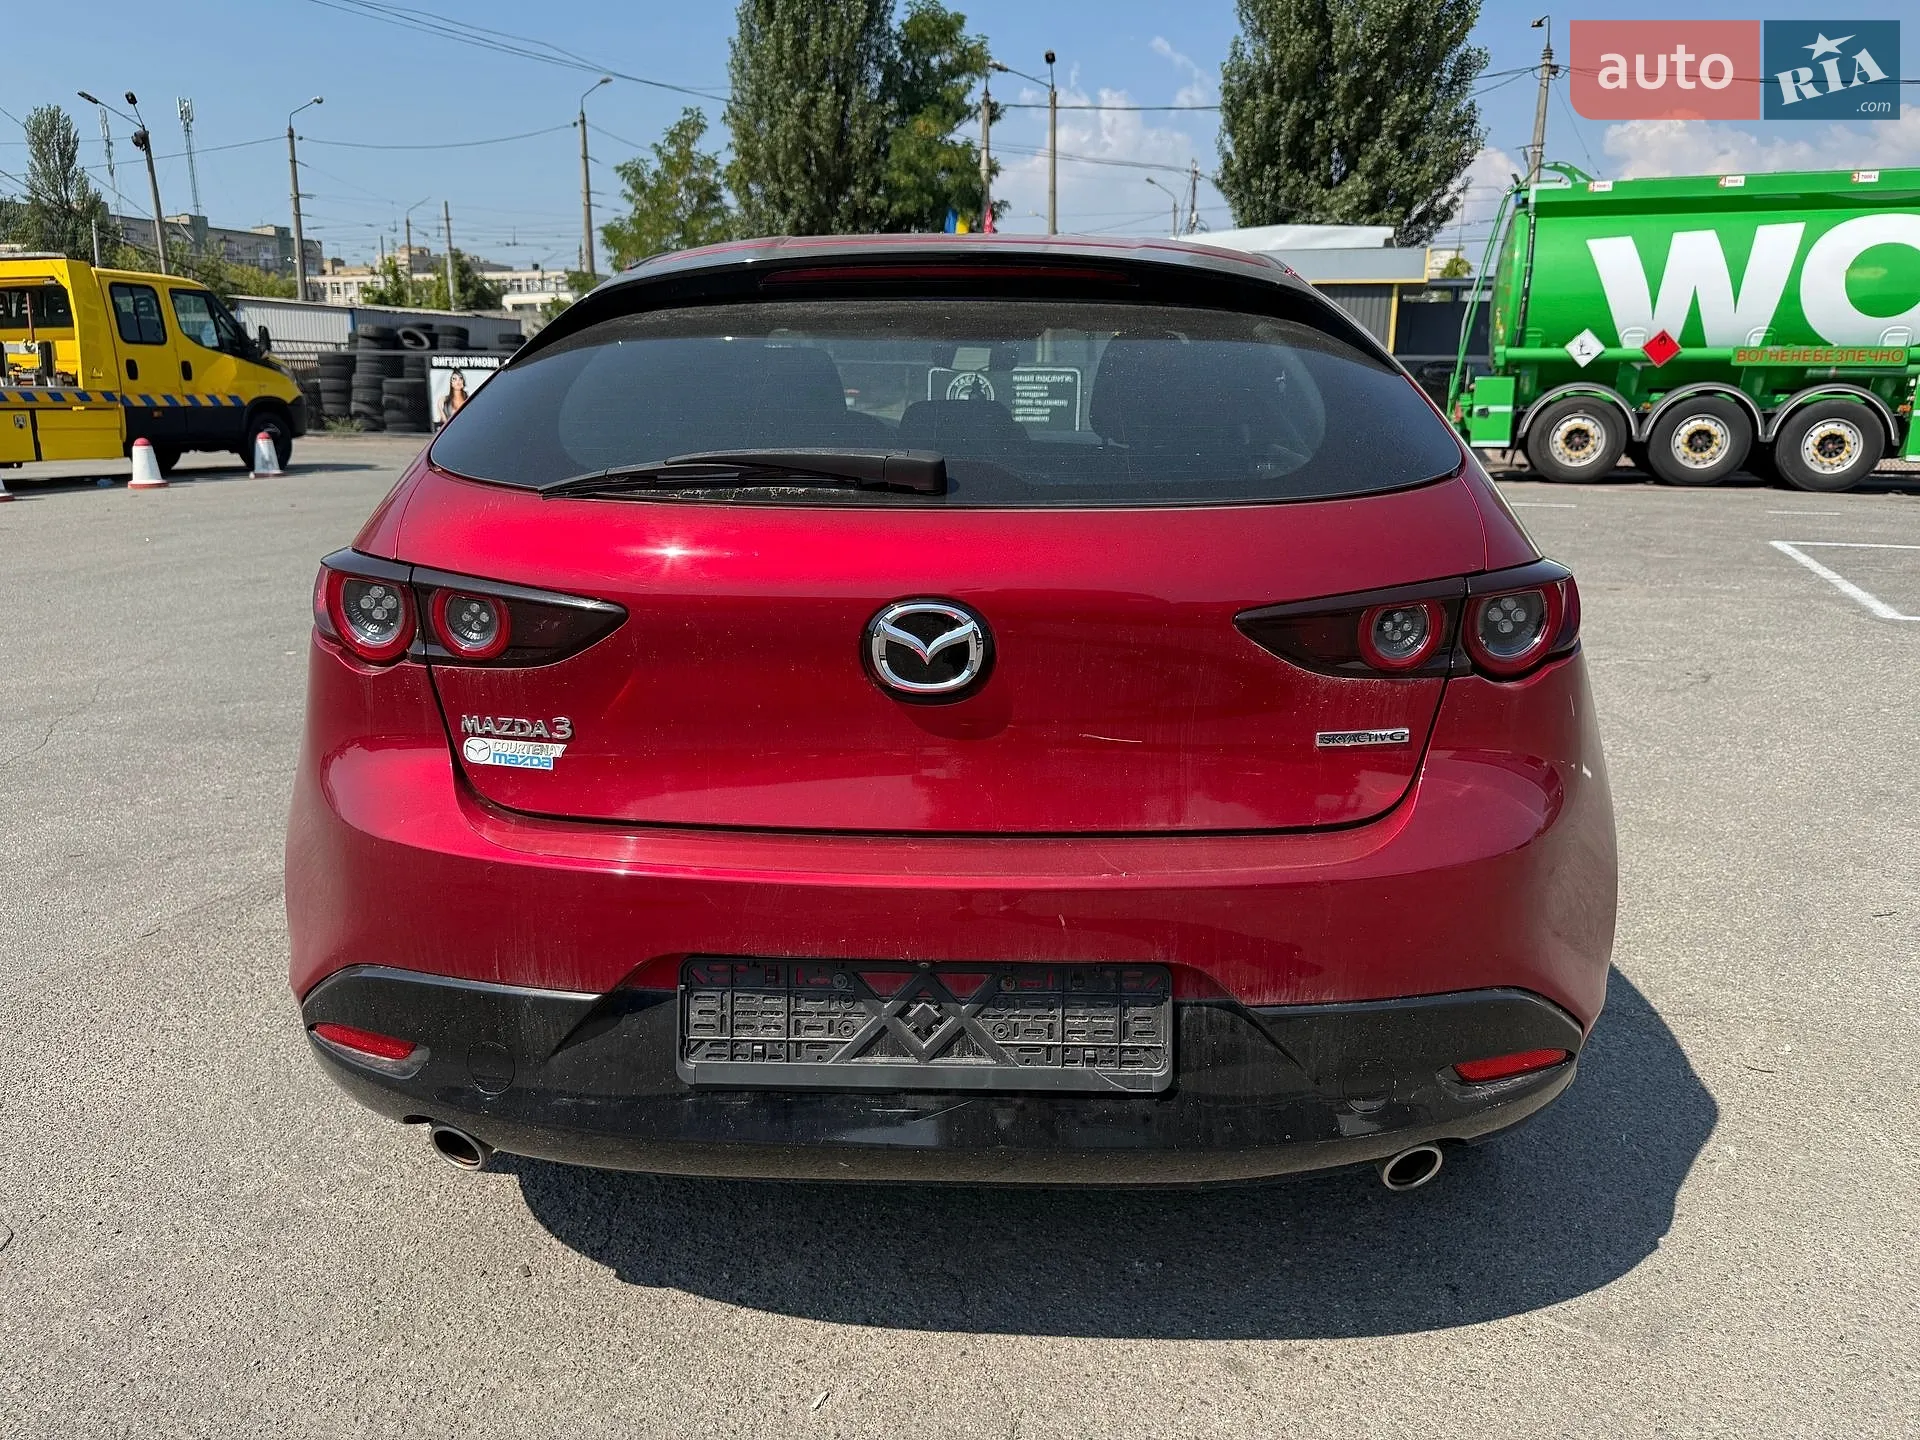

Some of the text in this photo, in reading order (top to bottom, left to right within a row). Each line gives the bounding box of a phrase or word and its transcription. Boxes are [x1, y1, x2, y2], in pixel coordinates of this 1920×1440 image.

[1736, 349, 1904, 363] ВОГНЕНЕБЕЗПЕЧНО
[461, 714, 573, 740] MAZDA 3
[492, 741, 565, 757] COURTENAY
[492, 752, 553, 768] mazda
